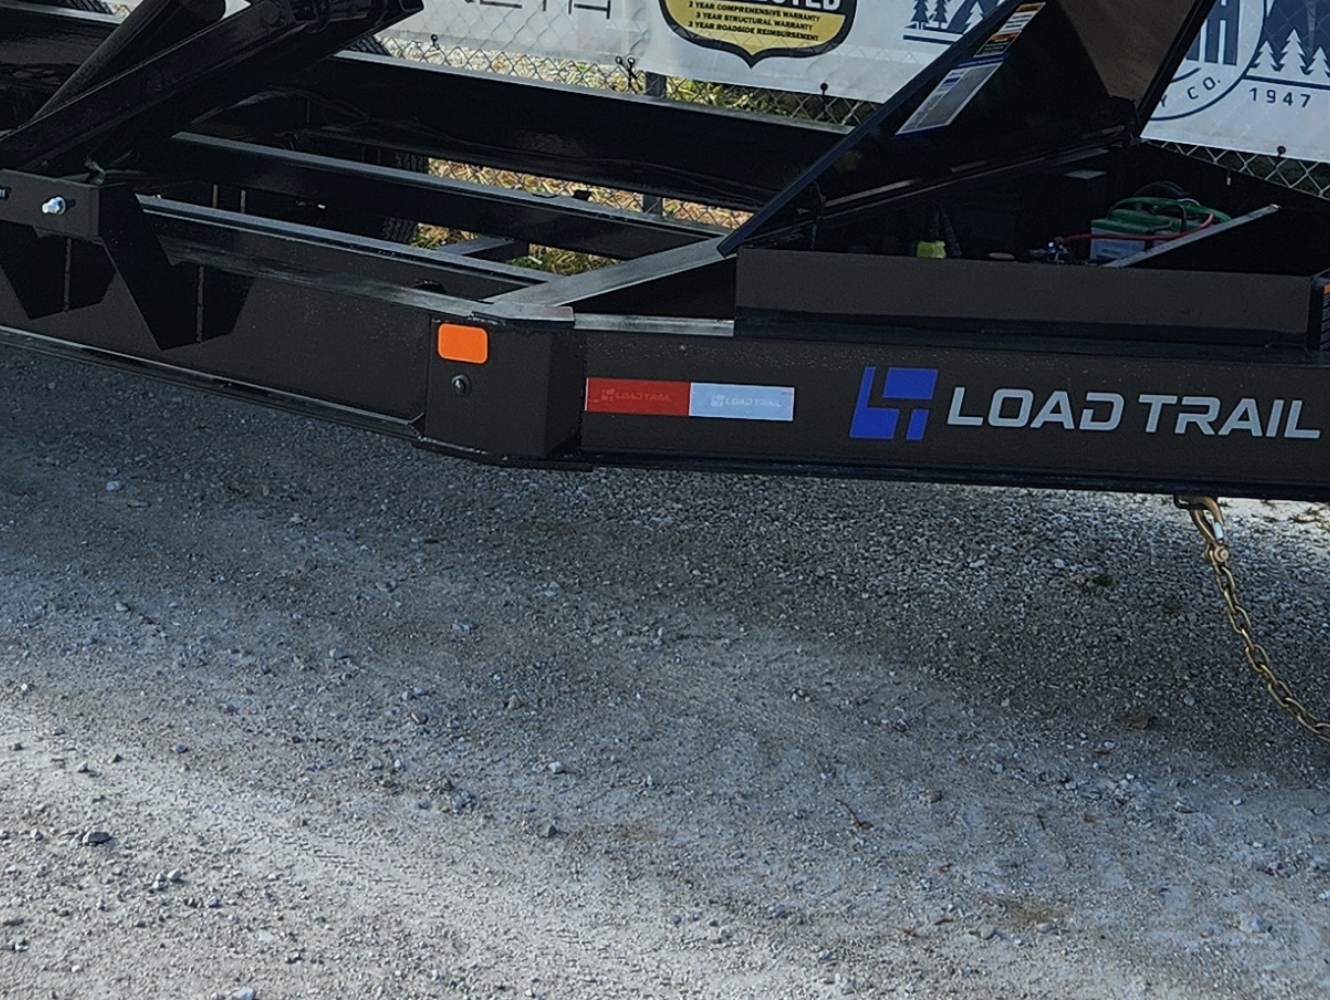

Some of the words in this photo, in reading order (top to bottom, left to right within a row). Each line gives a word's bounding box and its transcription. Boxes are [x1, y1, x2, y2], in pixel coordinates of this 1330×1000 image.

[695, 1, 715, 10] YEAR
[716, 3, 781, 17] COMPREHENSIVE
[783, 10, 821, 22] WARRANTY
[703, 12, 723, 20] YEAR
[724, 14, 772, 26] STRUCTURAL
[774, 19, 813, 31] WARRANTY
[695, 21, 715, 30] YEAR
[716, 23, 755, 34] ROADSIDE
[757, 27, 819, 42] REIMBURSEMENT
[1249, 86, 1312, 109] 1947
[946, 386, 1124, 432] LOAD
[1138, 393, 1321, 440] TRAIL
